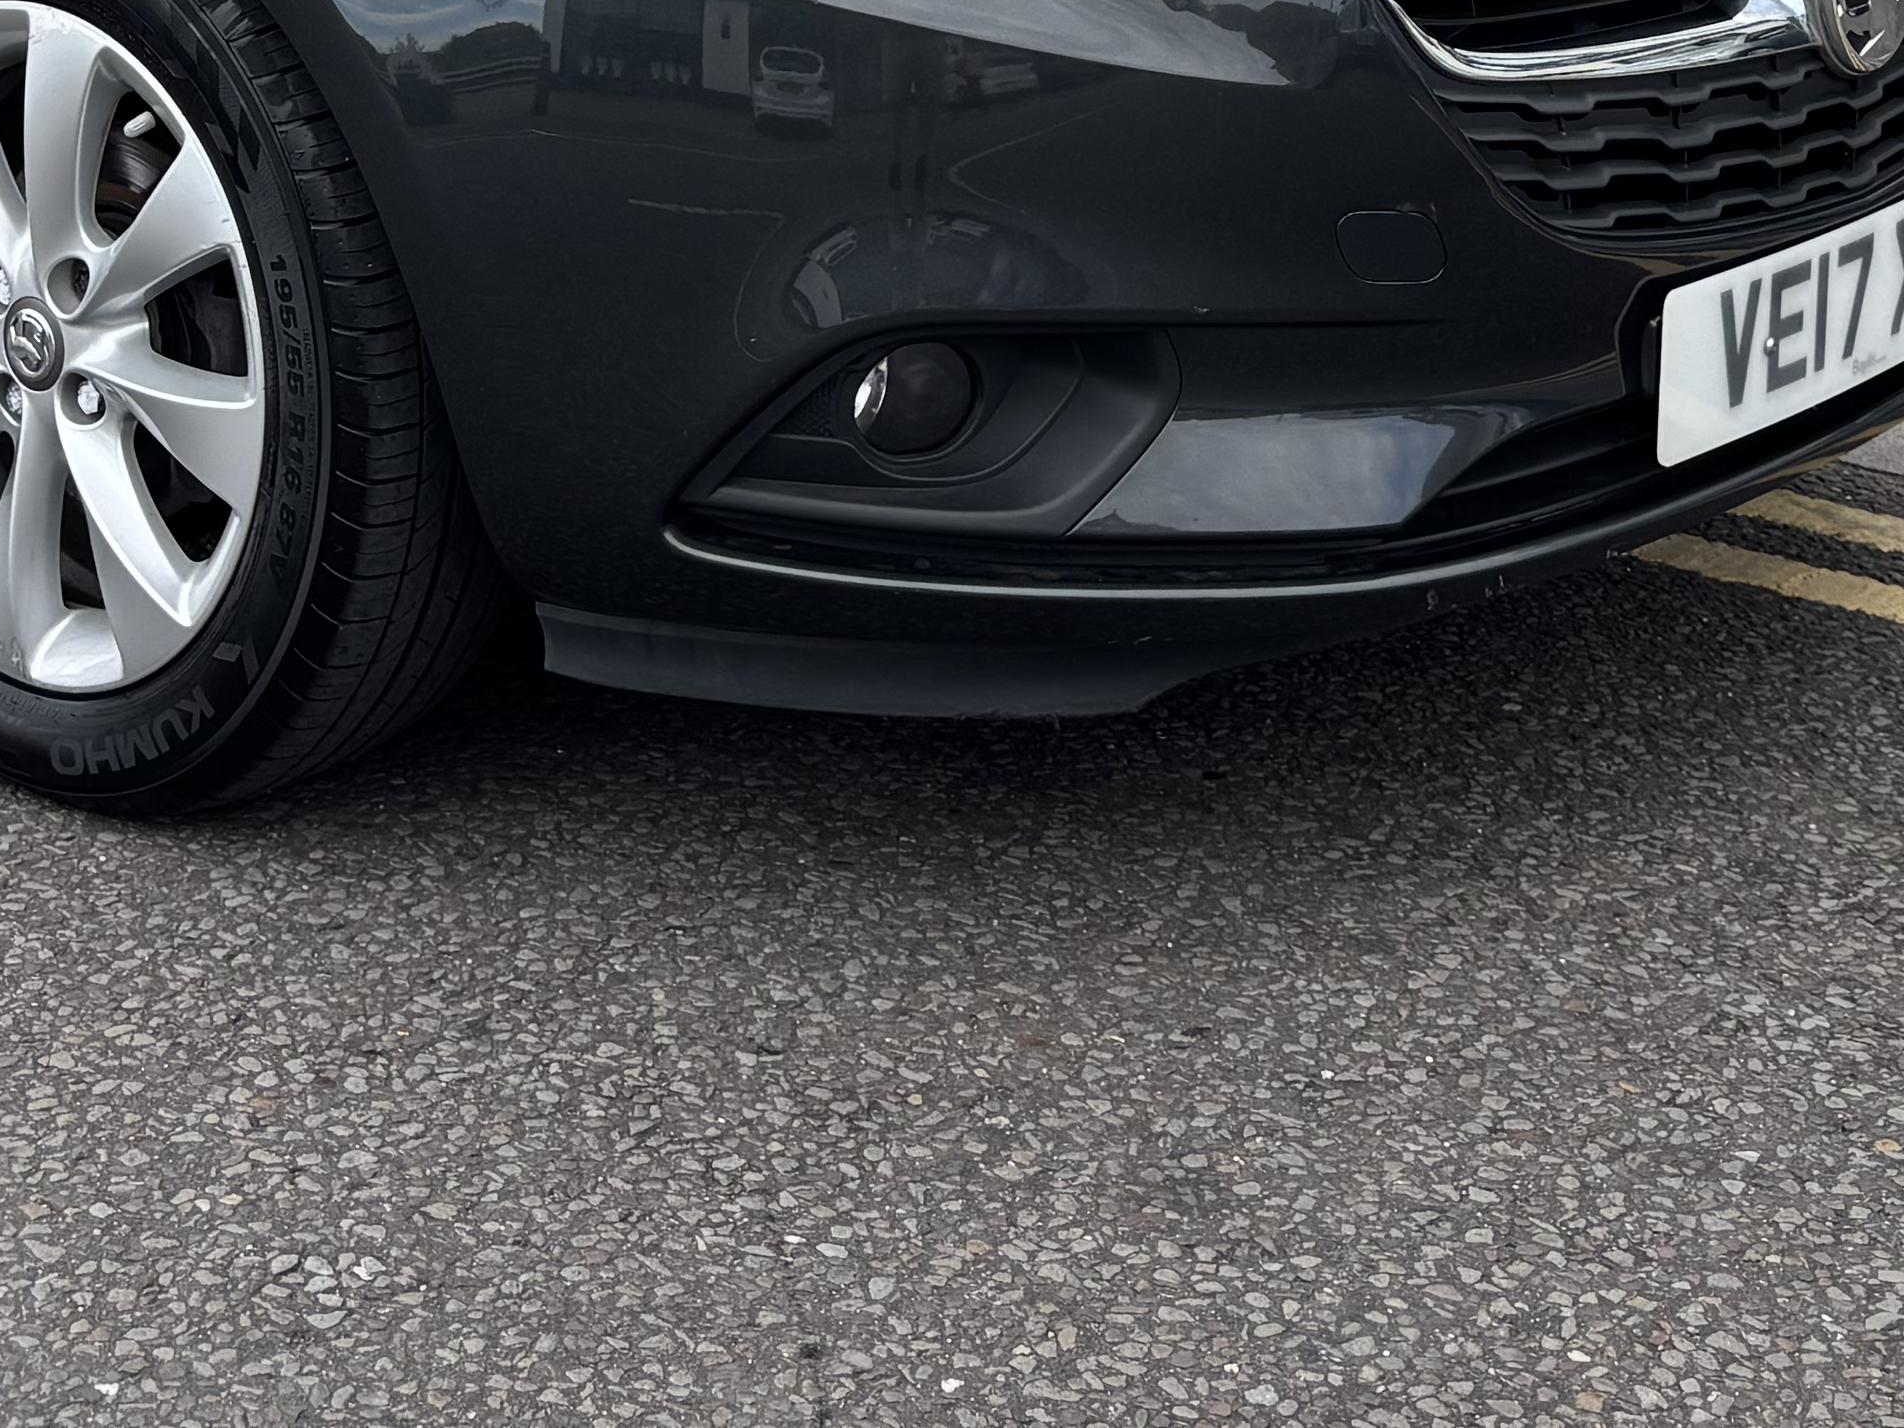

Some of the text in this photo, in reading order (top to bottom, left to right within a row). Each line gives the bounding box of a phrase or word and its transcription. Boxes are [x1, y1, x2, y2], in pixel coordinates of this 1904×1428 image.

[269, 253, 306, 398] 195/55
[1719, 232, 1875, 409] VE17
[282, 408, 307, 495] R16
[50, 684, 215, 776] KUMHO
